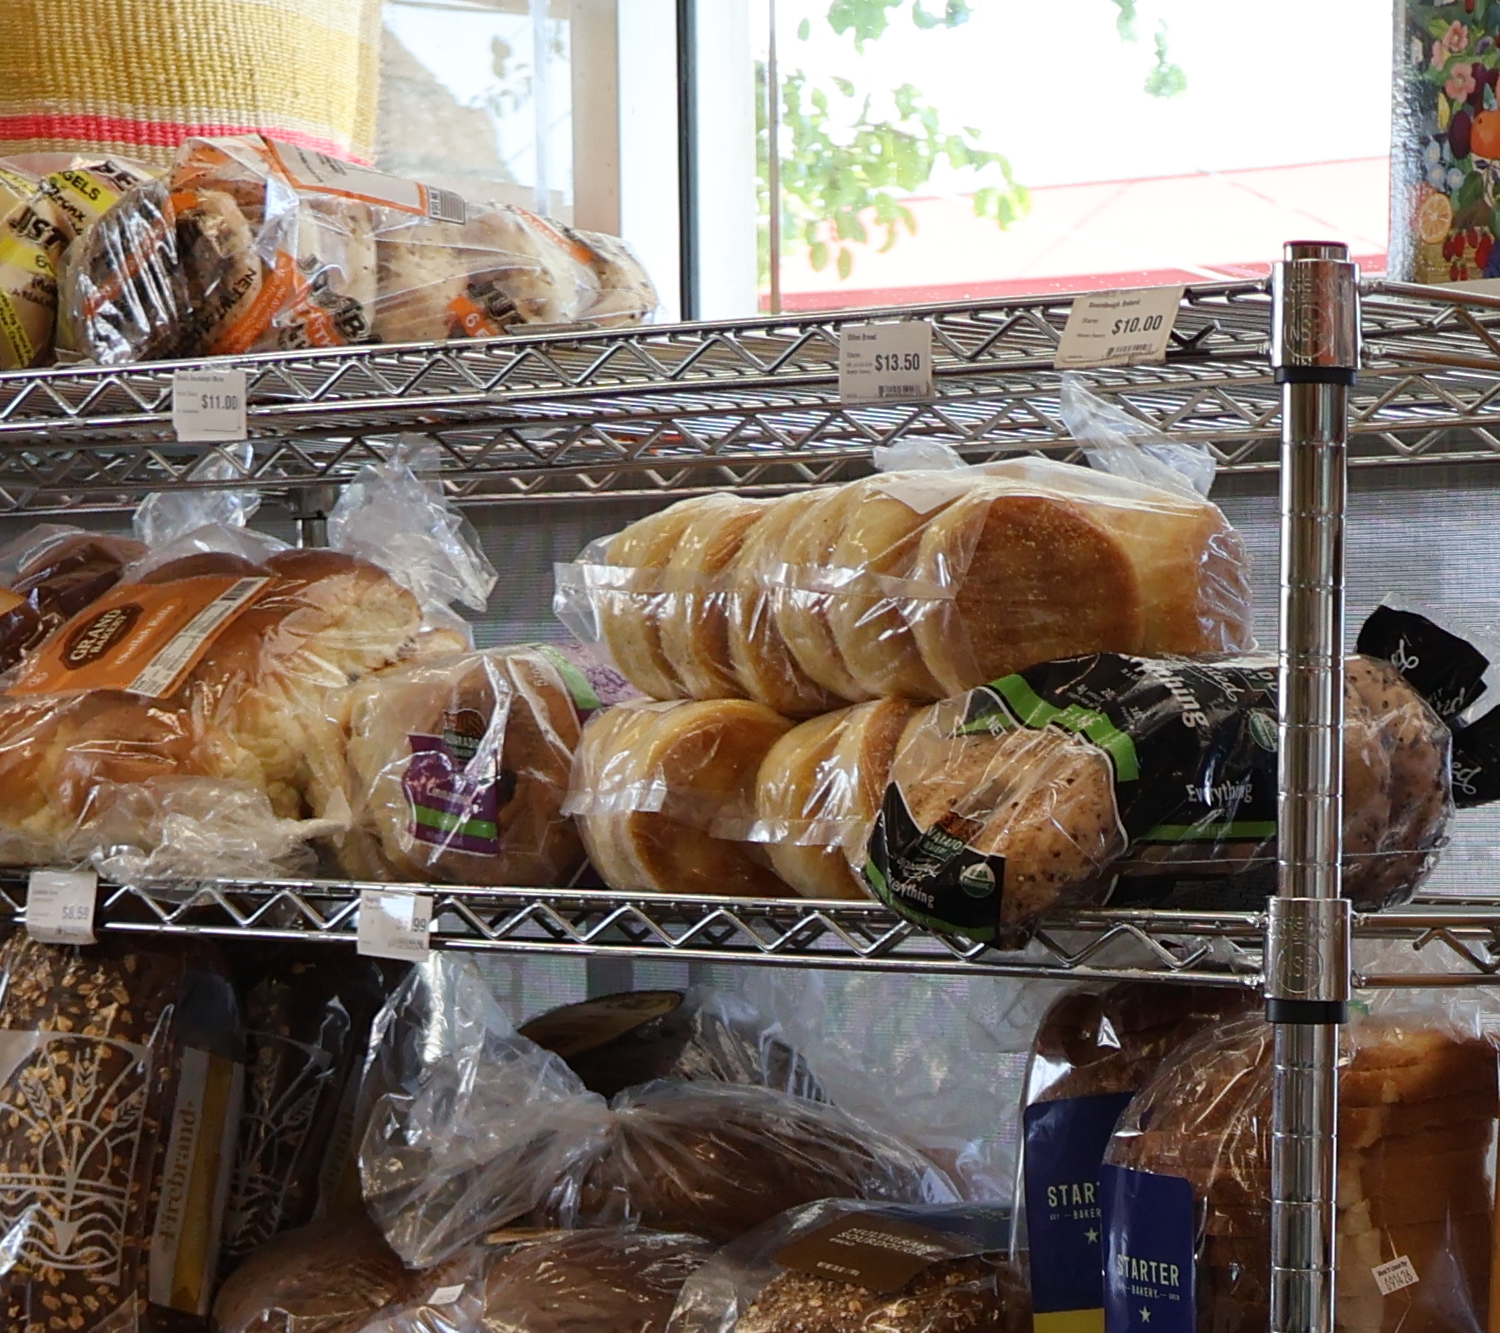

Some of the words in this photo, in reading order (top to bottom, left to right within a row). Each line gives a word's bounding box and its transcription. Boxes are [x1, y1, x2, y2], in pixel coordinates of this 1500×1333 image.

[1111, 314, 1164, 336] $10.00
[875, 352, 920, 372] $13.50
[69, 608, 121, 662] GRAND
[1185, 782, 1253, 805] Everything
[160, 1100, 198, 1251] Firebrand
[1115, 1254, 1181, 1287] STARTER
